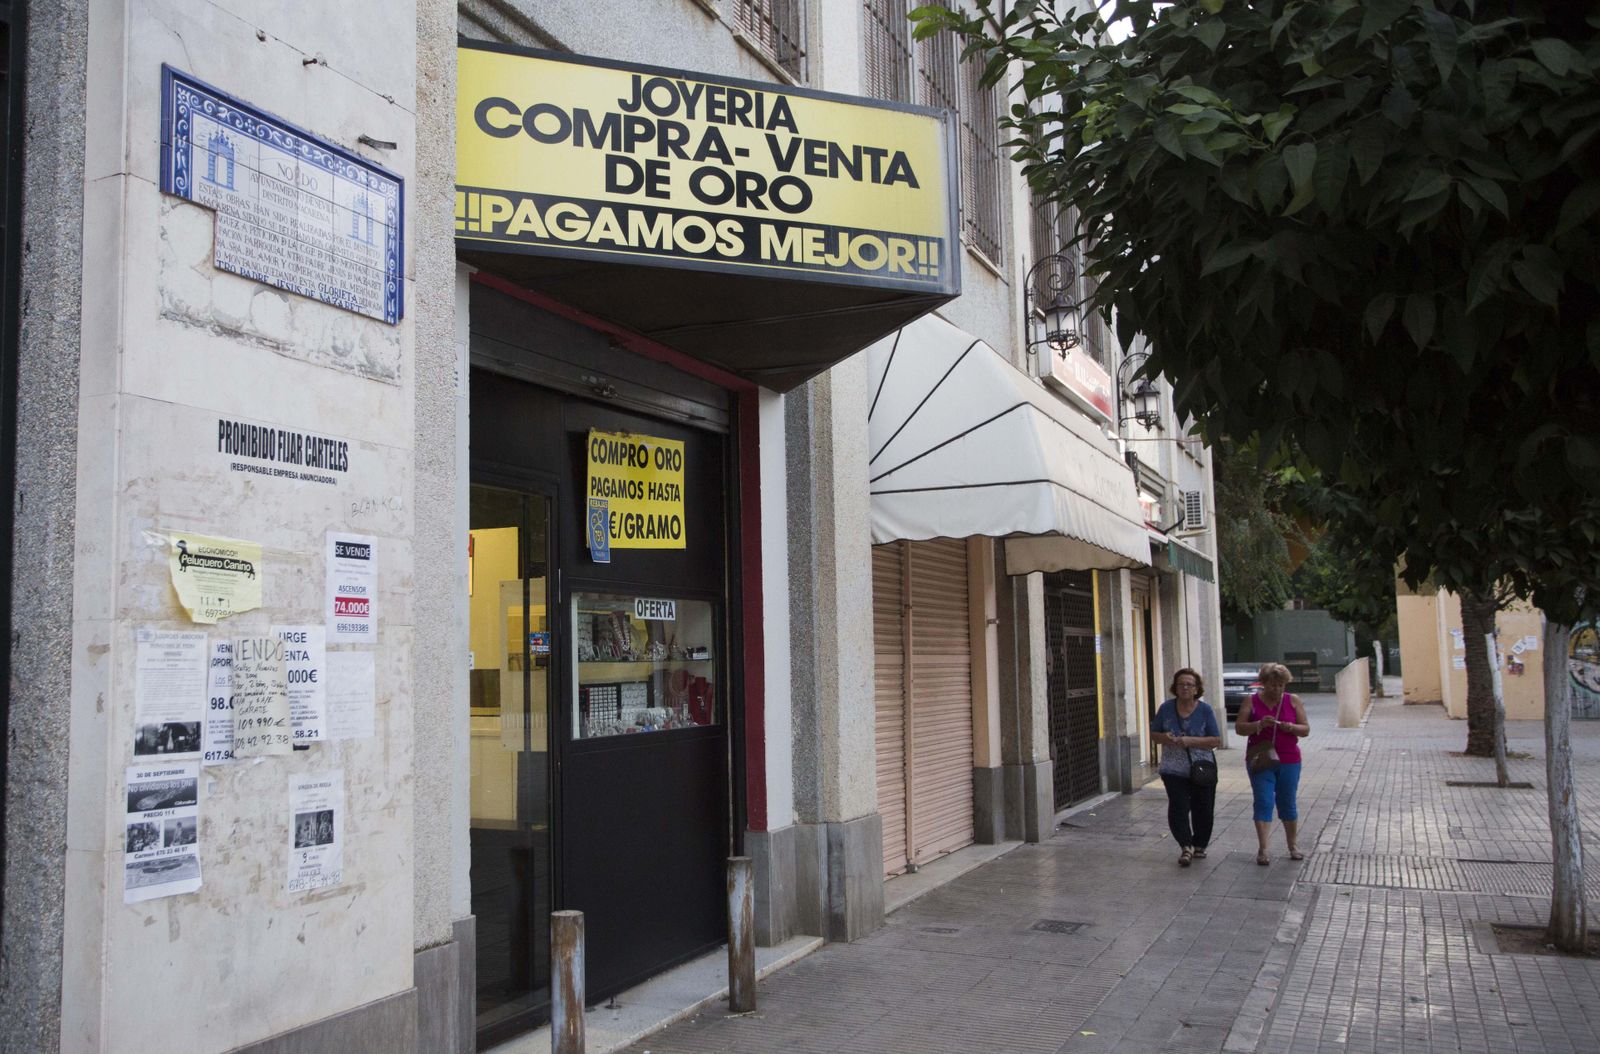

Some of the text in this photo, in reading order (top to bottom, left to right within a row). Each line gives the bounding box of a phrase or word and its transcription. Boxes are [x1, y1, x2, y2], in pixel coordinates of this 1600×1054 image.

[618, 74, 799, 134] JOYERIA
[765, 133, 920, 189] VENTA
[250, 171, 305, 203] AYUNTAMIENTO
[314, 197, 339, 216] SEVILLA
[605, 153, 813, 214] DE ORO
[198, 181, 223, 200] ESTAS
[225, 192, 250, 210] OBRAS
[254, 203, 270, 218] HAN
[272, 210, 288, 225] SIDO
[289, 216, 332, 241] REALIZADAS
[262, 188, 293, 209] DISTRITO
[198, 193, 239, 217] MACARENA
[242, 209, 266, 227] SIENDO
[278, 223, 310, 243] DELEGADO
[244, 235, 284, 257] PARROQUIAL
[249, 225, 279, 244] PETICION
[760, 223, 939, 277] MEJOR!!
[240, 267, 269, 284] PADRE
[272, 277, 301, 294] JESUS
[303, 287, 315, 298] DE
[257, 251, 279, 267] AMOR
[281, 259, 286, 269] Y
[287, 261, 338, 286] COMERCIANTES
[349, 281, 378, 300] MERCADO
[317, 282, 357, 303] GLORIETA
[218, 419, 349, 473] PROHIBIDO FIJAR CARTELES
[591, 437, 681, 472] COMPRO ORO
[230, 462, 338, 486] (RESPONSABLE EMPRESA ANUNCIADORA)
[591, 476, 680, 502] PAGAMOS HASTA
[609, 511, 681, 540] €/GRAMO
[181, 554, 252, 571] Peluquero Canino
[335, 545, 370, 558] SE VENDE
[338, 585, 367, 593] ASCENSOR
[335, 601, 370, 614] 74.000€
[636, 599, 674, 618] OFERTA
[233, 638, 284, 662] VENDO
[152, 769, 185, 777] SEPTIEMBRE
